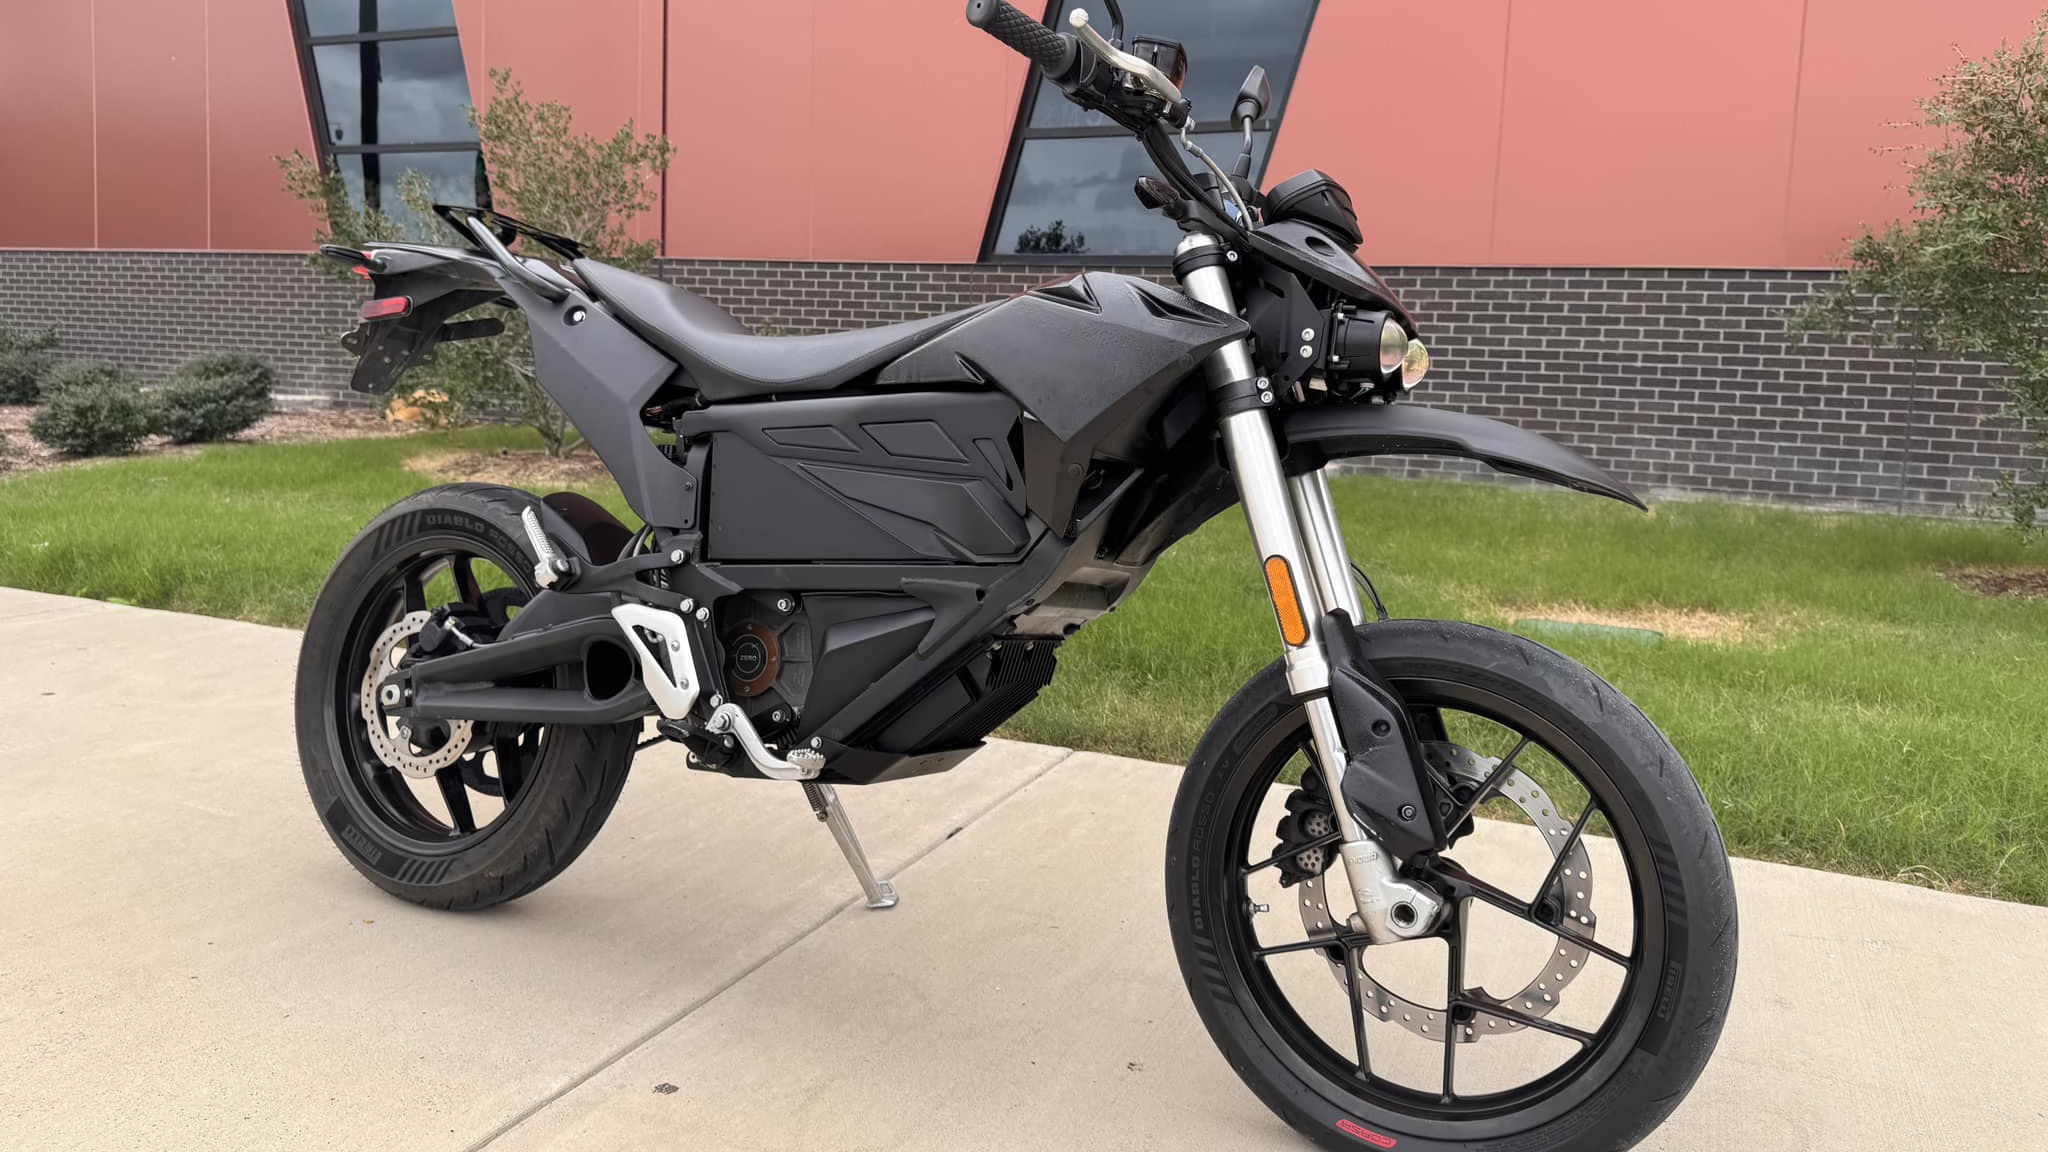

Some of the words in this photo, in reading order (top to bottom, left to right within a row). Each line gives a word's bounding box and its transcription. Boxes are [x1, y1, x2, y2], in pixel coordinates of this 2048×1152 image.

[426, 513, 485, 534] DIABLO
[739, 654, 757, 662] ZERO
[1192, 792, 1216, 851] ROSSO
[1191, 855, 1204, 930] DIABLO
[1342, 1121, 1391, 1145] CORSA
